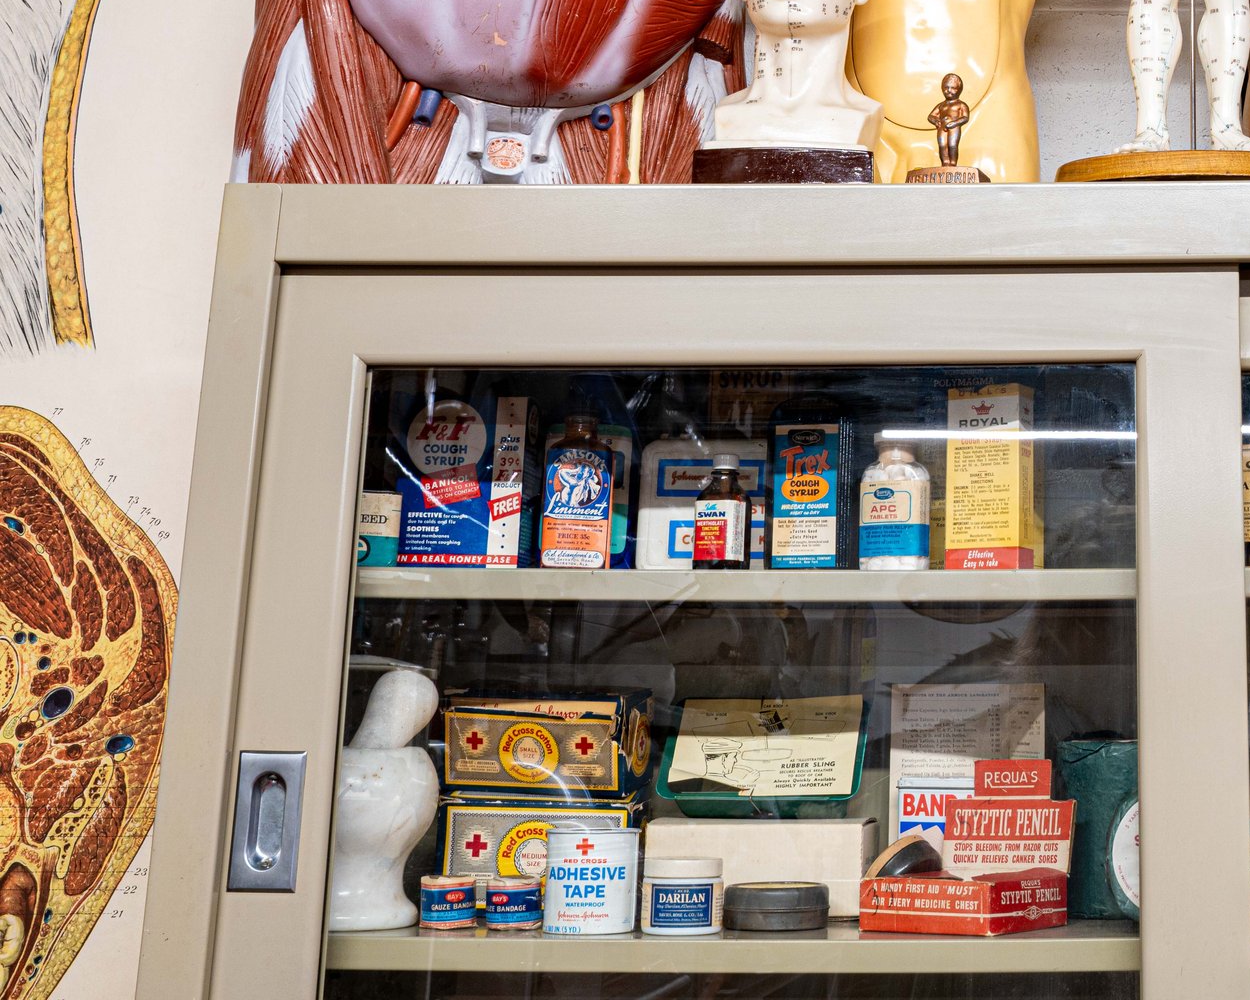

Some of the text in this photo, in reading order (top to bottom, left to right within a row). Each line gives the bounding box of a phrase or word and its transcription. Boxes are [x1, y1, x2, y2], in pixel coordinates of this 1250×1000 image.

[52, 407, 64, 416] 77
[958, 417, 1009, 428] ROYAL
[415, 415, 476, 442] F&F
[80, 437, 91, 446] 76
[423, 444, 468, 455] COUGH
[94, 458, 104, 467] 75
[424, 456, 465, 466] SYRUP
[500, 457, 520, 467] 39¢
[553, 449, 606, 472] SAMSON'S
[780, 445, 831, 480] Trex
[107, 474, 117, 483] 71
[424, 475, 470, 490] BANICOL
[790, 480, 820, 488] COUGH
[789, 489, 820, 497] SYRUP
[127, 496, 139, 504] 73
[543, 491, 609, 516] Liniment
[140, 507, 151, 516] 74
[493, 497, 520, 516] FREE
[870, 504, 897, 513] APC
[149, 517, 162, 526] 70
[360, 514, 388, 524] EED
[157, 531, 170, 540] 69
[421, 555, 445, 563] REAL
[448, 555, 482, 563] HONEY
[486, 556, 511, 564] BASE
[967, 550, 994, 559] Effective
[963, 559, 999, 569] Easy to take
[502, 727, 553, 756] Red Cross Cotton
[519, 746, 539, 754] SMALL
[984, 770, 1039, 789] REQUA'S
[902, 793, 947, 817] BAN
[953, 808, 1062, 837] STYPTIC PENCIL
[502, 828, 544, 859] Red Cross
[953, 842, 1059, 852] STOPS BLEEDING FROM RAZOR CUTS
[521, 852, 547, 860] MEDIUM
[953, 854, 1058, 865] QUICKLY RELIEVES CANKER SORES
[134, 867, 148, 876] 23
[550, 866, 626, 881] ADHESIVE
[124, 885, 138, 894] 22
[563, 884, 606, 899] TAPE
[880, 883, 903, 893] HANDY
[905, 884, 926, 893] FIRST
[927, 884, 940, 893] AID
[942, 885, 979, 895] "MUST"
[659, 893, 706, 904] DARILAN
[1000, 887, 1061, 905] STYPTIC PENCIL
[431, 903, 451, 911] GAUZE
[871, 896, 979, 910] FOR EVERY MEDICINE CHEST
[496, 904, 526, 913] BANDAGE
[111, 910, 123, 918] 21
